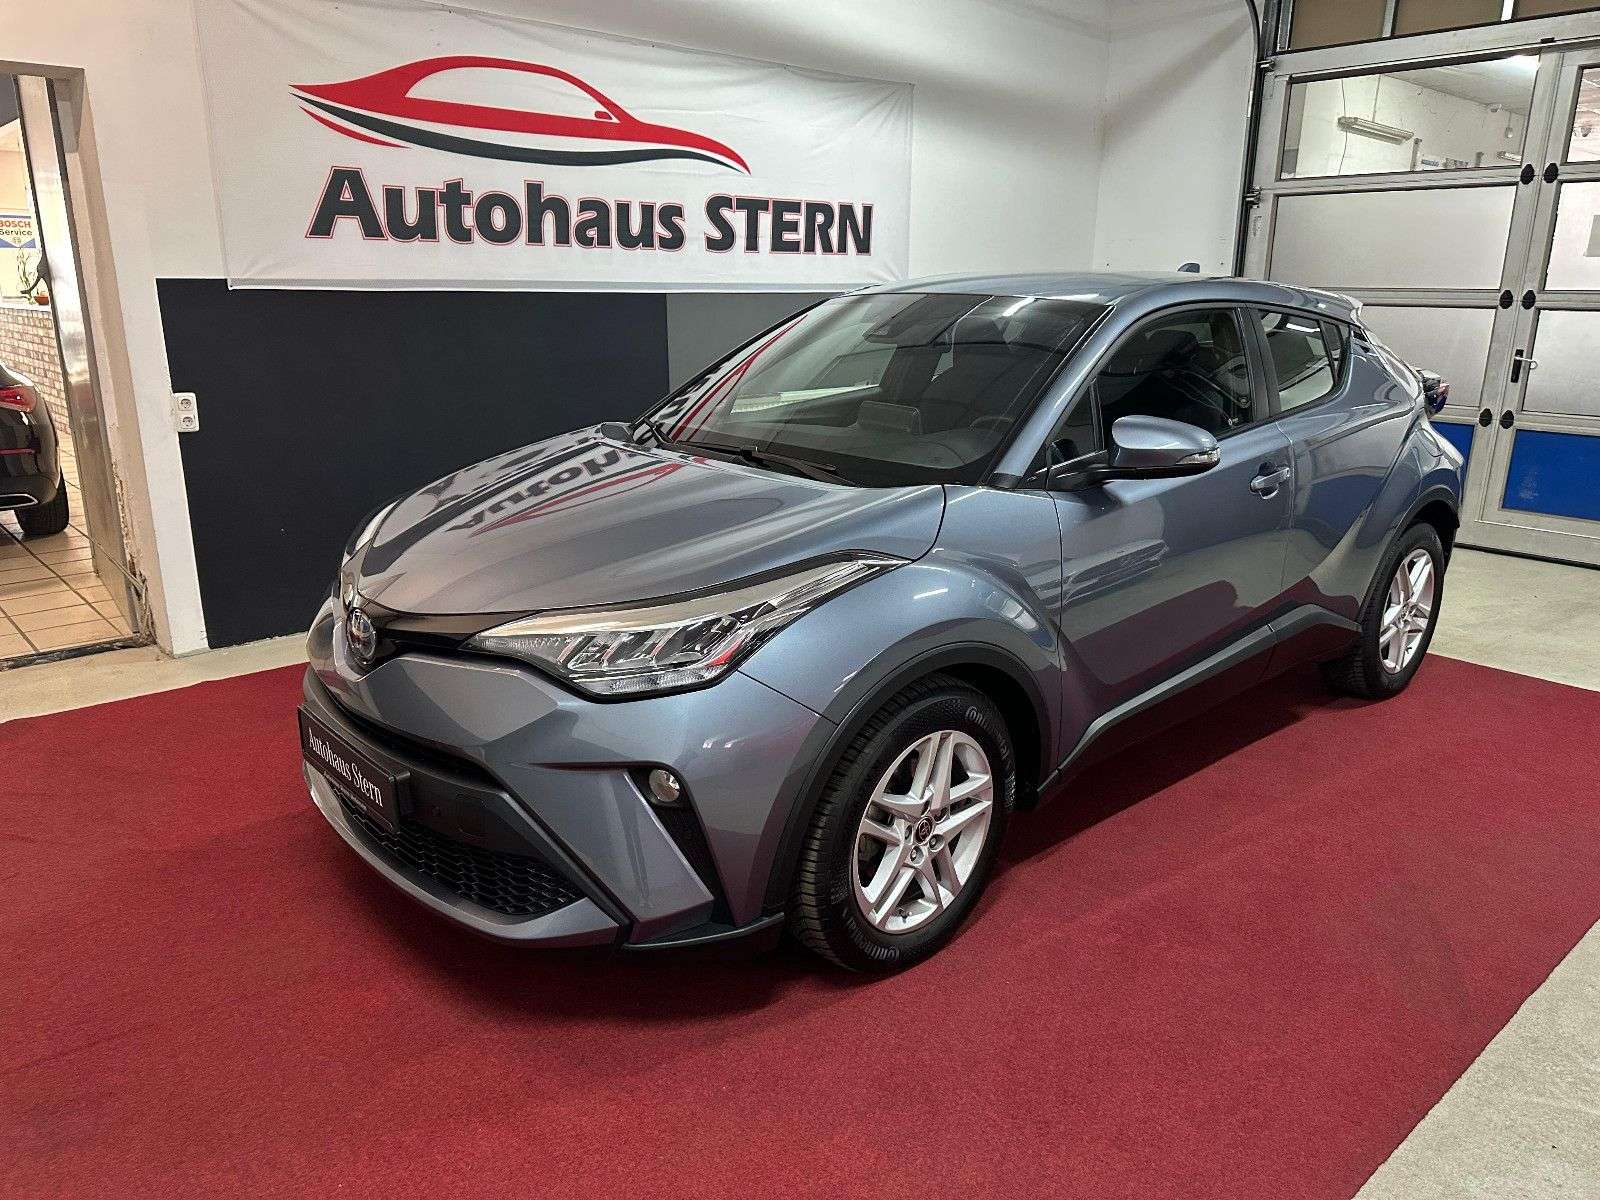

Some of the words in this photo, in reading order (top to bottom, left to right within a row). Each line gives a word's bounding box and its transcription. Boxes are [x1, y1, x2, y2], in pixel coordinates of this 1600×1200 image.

[304, 165, 686, 252] Autohaus
[704, 193, 874, 256] STERN
[308, 727, 352, 780] Autohaus
[351, 763, 384, 807] Stern
